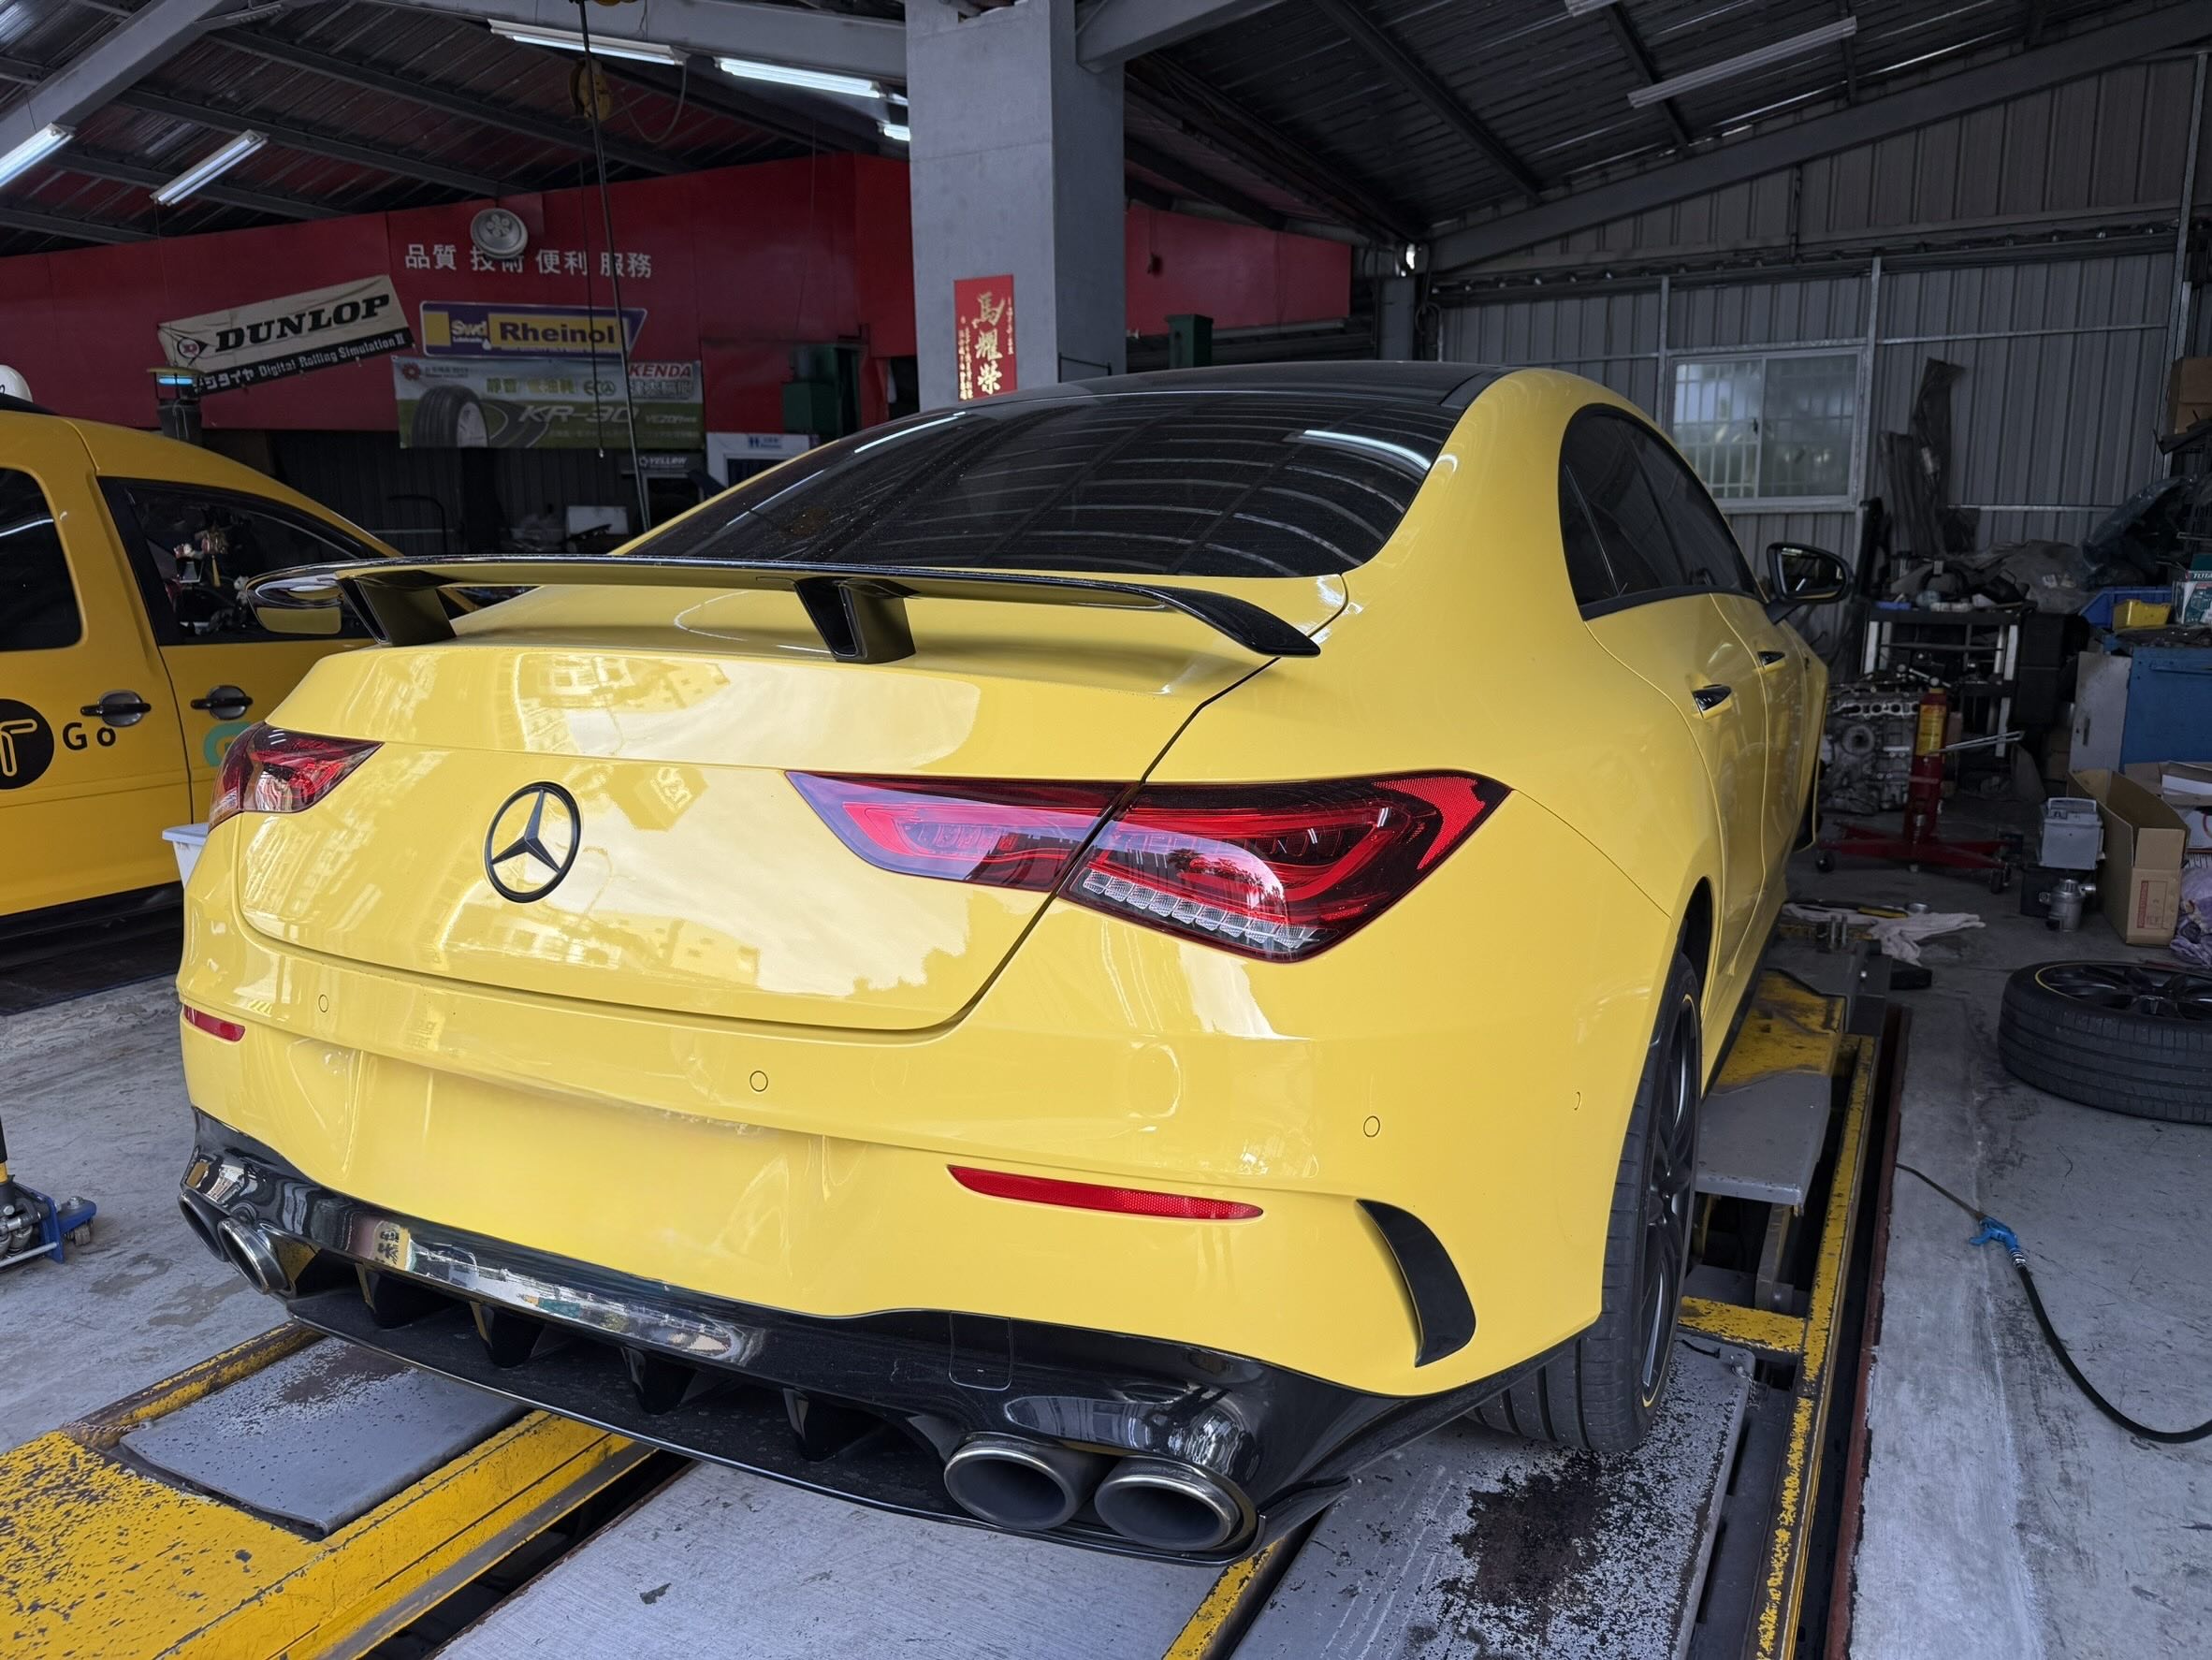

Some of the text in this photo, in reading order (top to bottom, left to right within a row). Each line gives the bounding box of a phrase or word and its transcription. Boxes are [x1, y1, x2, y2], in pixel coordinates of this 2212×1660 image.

[405, 244, 457, 270] 品質
[535, 249, 588, 275] 便利
[600, 251, 652, 278] 服務
[215, 294, 390, 353] DUNLOP
[499, 322, 616, 344] Rheinol
[258, 360, 297, 377] Digital
[298, 352, 338, 368] Rolling
[338, 337, 395, 358] Simulation
[629, 364, 691, 378] KENDA
[62, 721, 117, 750] Go
